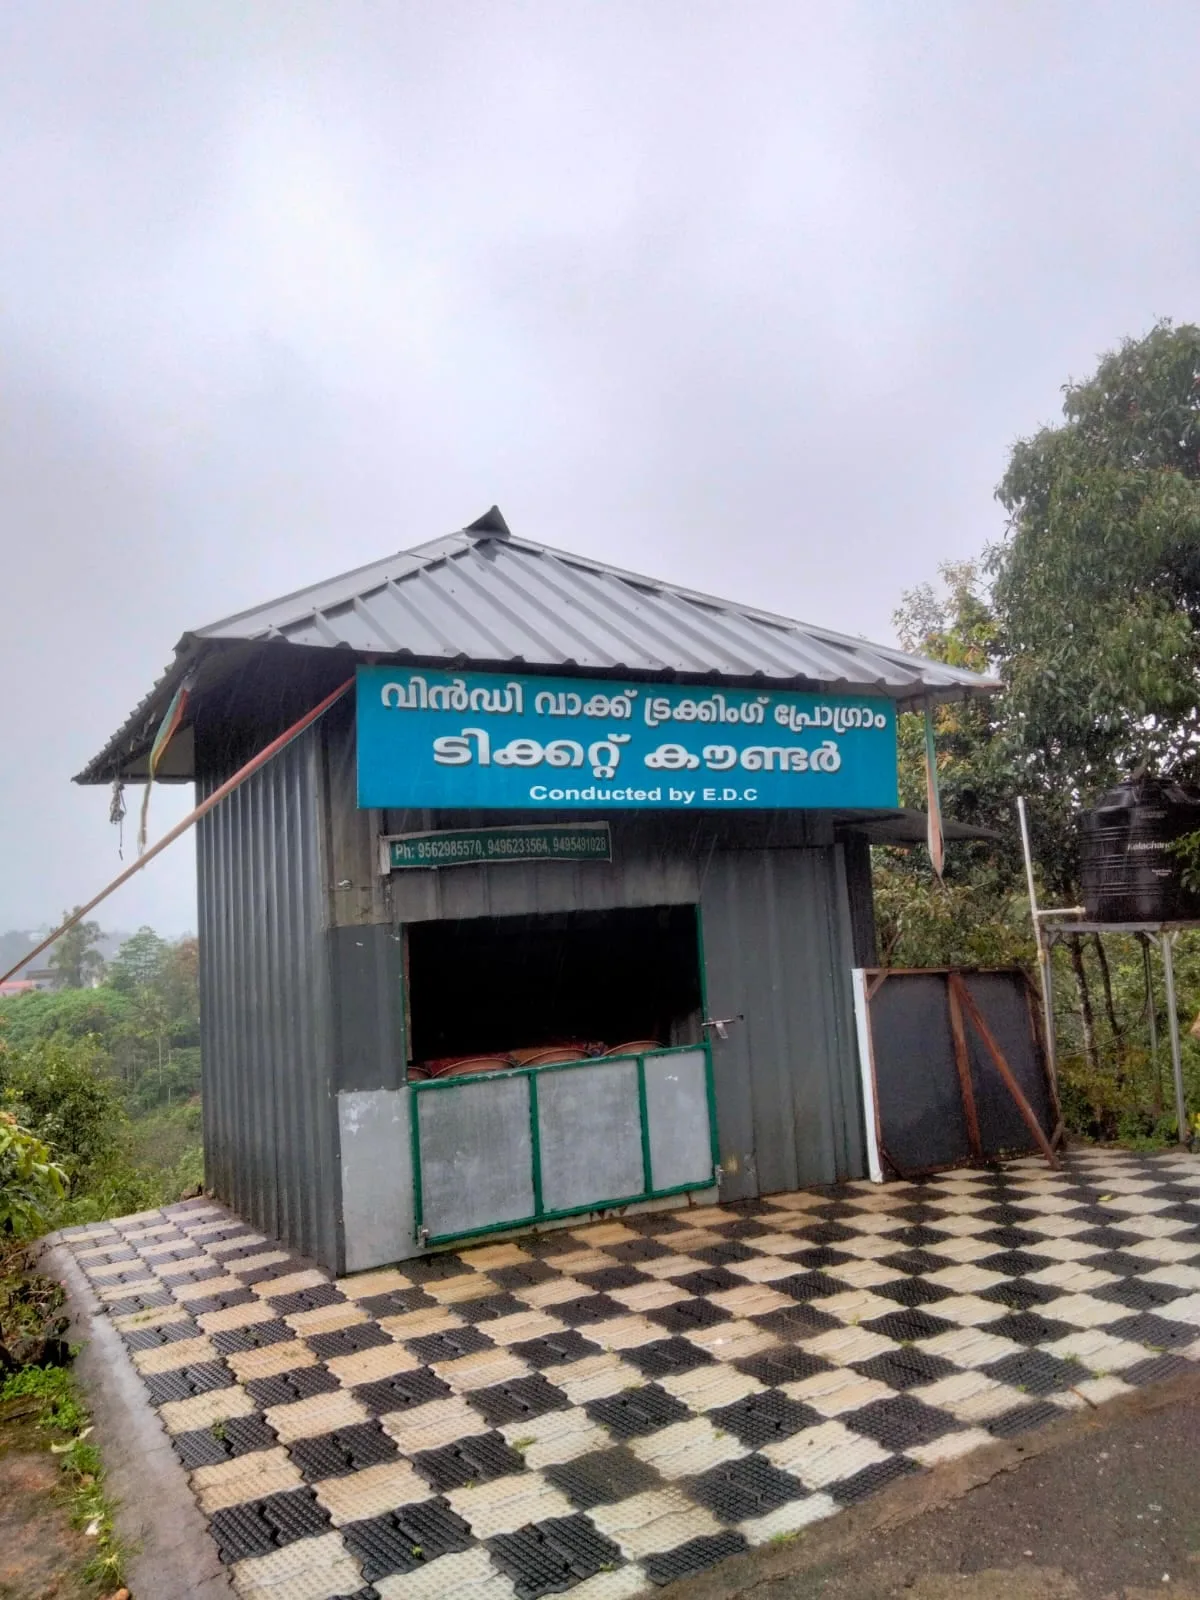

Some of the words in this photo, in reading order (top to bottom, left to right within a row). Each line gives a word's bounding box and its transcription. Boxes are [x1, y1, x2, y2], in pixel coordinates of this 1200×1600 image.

[381, 676, 524, 714] വിൻഡി
[534, 689, 638, 719] വാക്ക്
[644, 694, 770, 727] ട്രക്കിംഗ്
[774, 704, 887, 733] പ്രോഗ്രാം
[432, 727, 632, 779] ടിക്കറ്റ്
[644, 740, 842, 774] കൗണ്ടർ
[529, 786, 661, 801] Conducted
[669, 788, 695, 804] by
[703, 789, 758, 801] E.D.C
[395, 844, 415, 860] Ph:
[418, 840, 486, 858] 9562985570,
